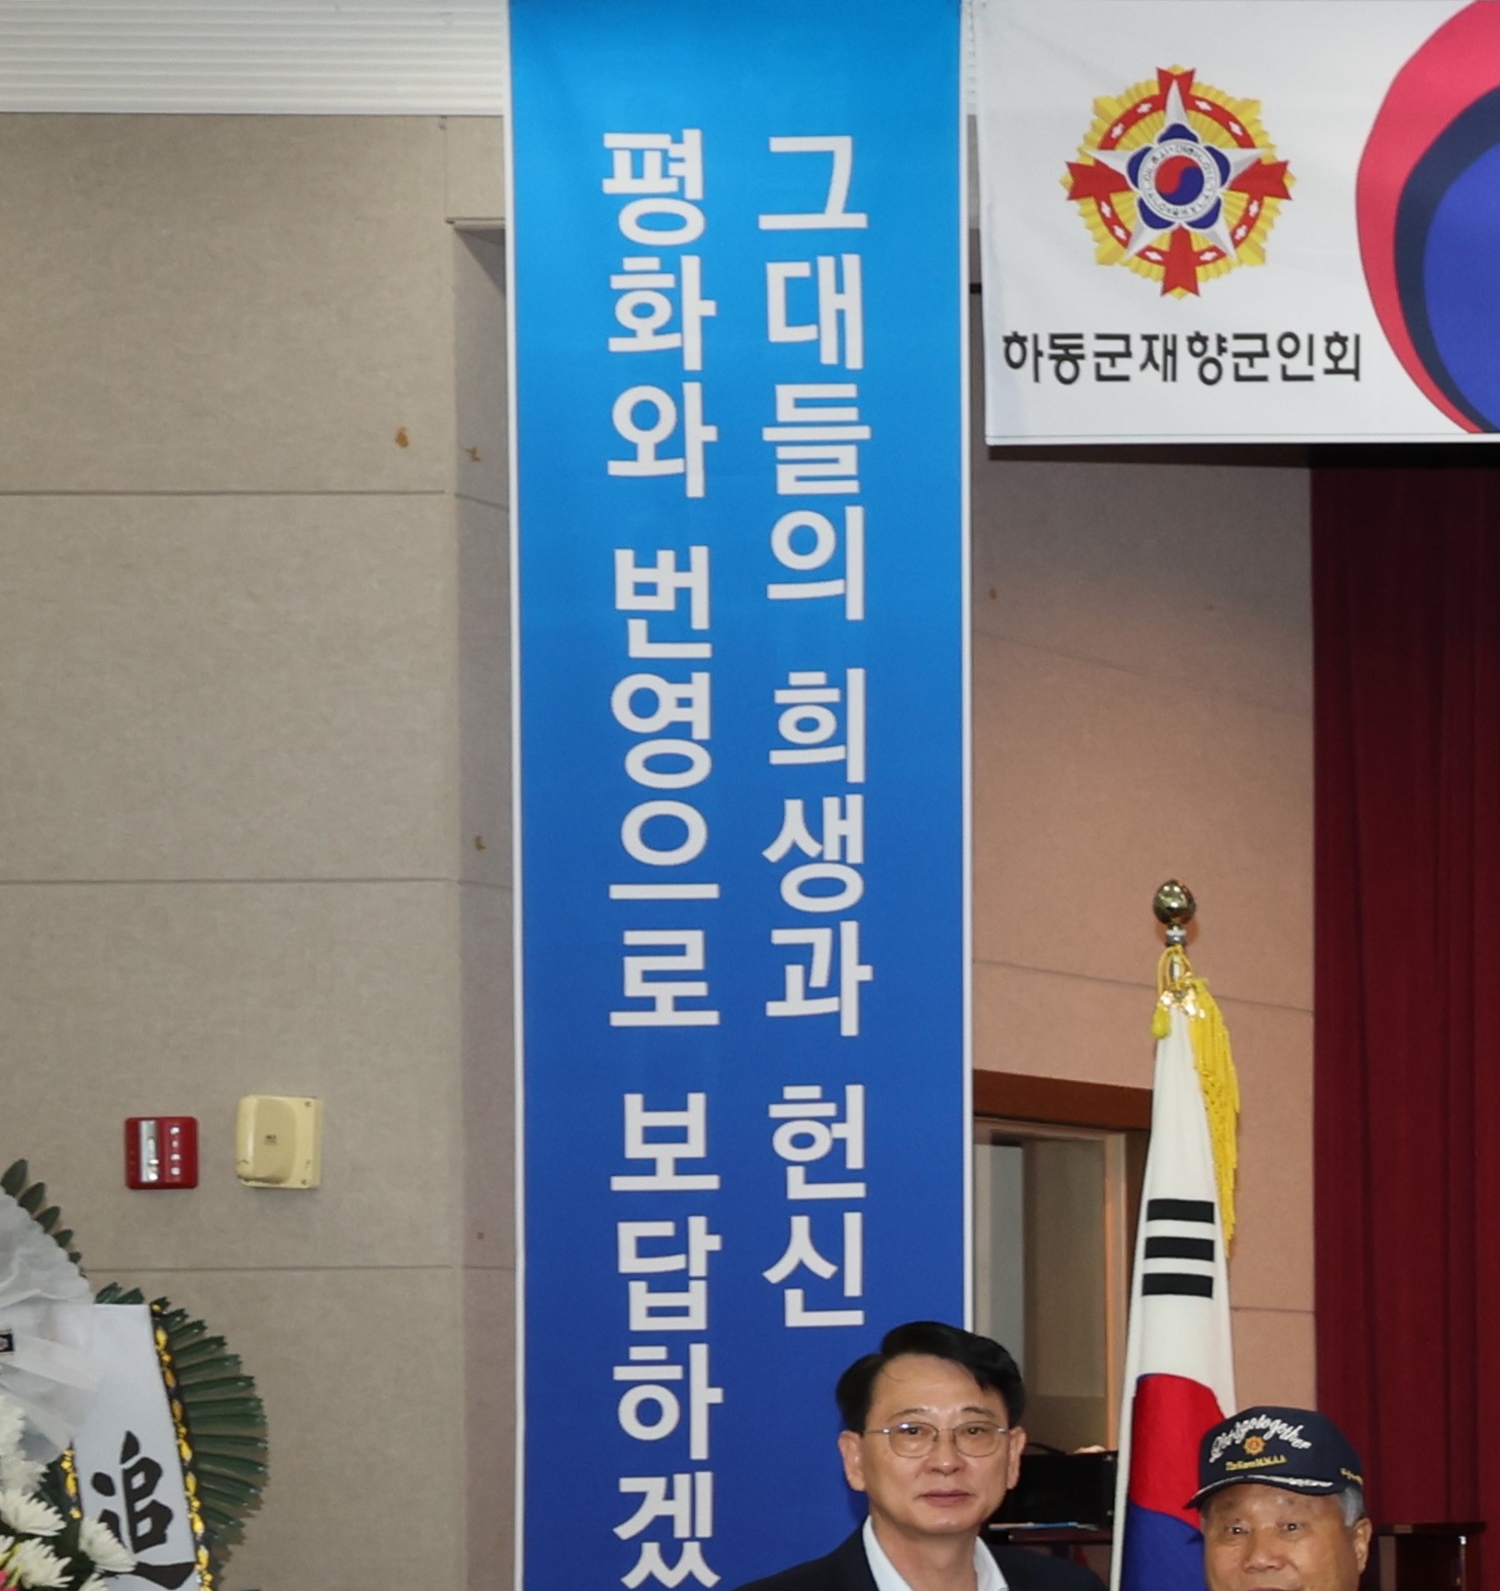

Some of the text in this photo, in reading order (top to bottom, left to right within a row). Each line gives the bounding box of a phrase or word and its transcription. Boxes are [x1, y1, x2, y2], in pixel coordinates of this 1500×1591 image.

[602, 129, 717, 498] 평화와
[1001, 330, 1363, 388] 하동군재향군인회
[610, 546, 719, 1026] 번영으로
[759, 136, 873, 1327] 그대들의 희생과 헌신
